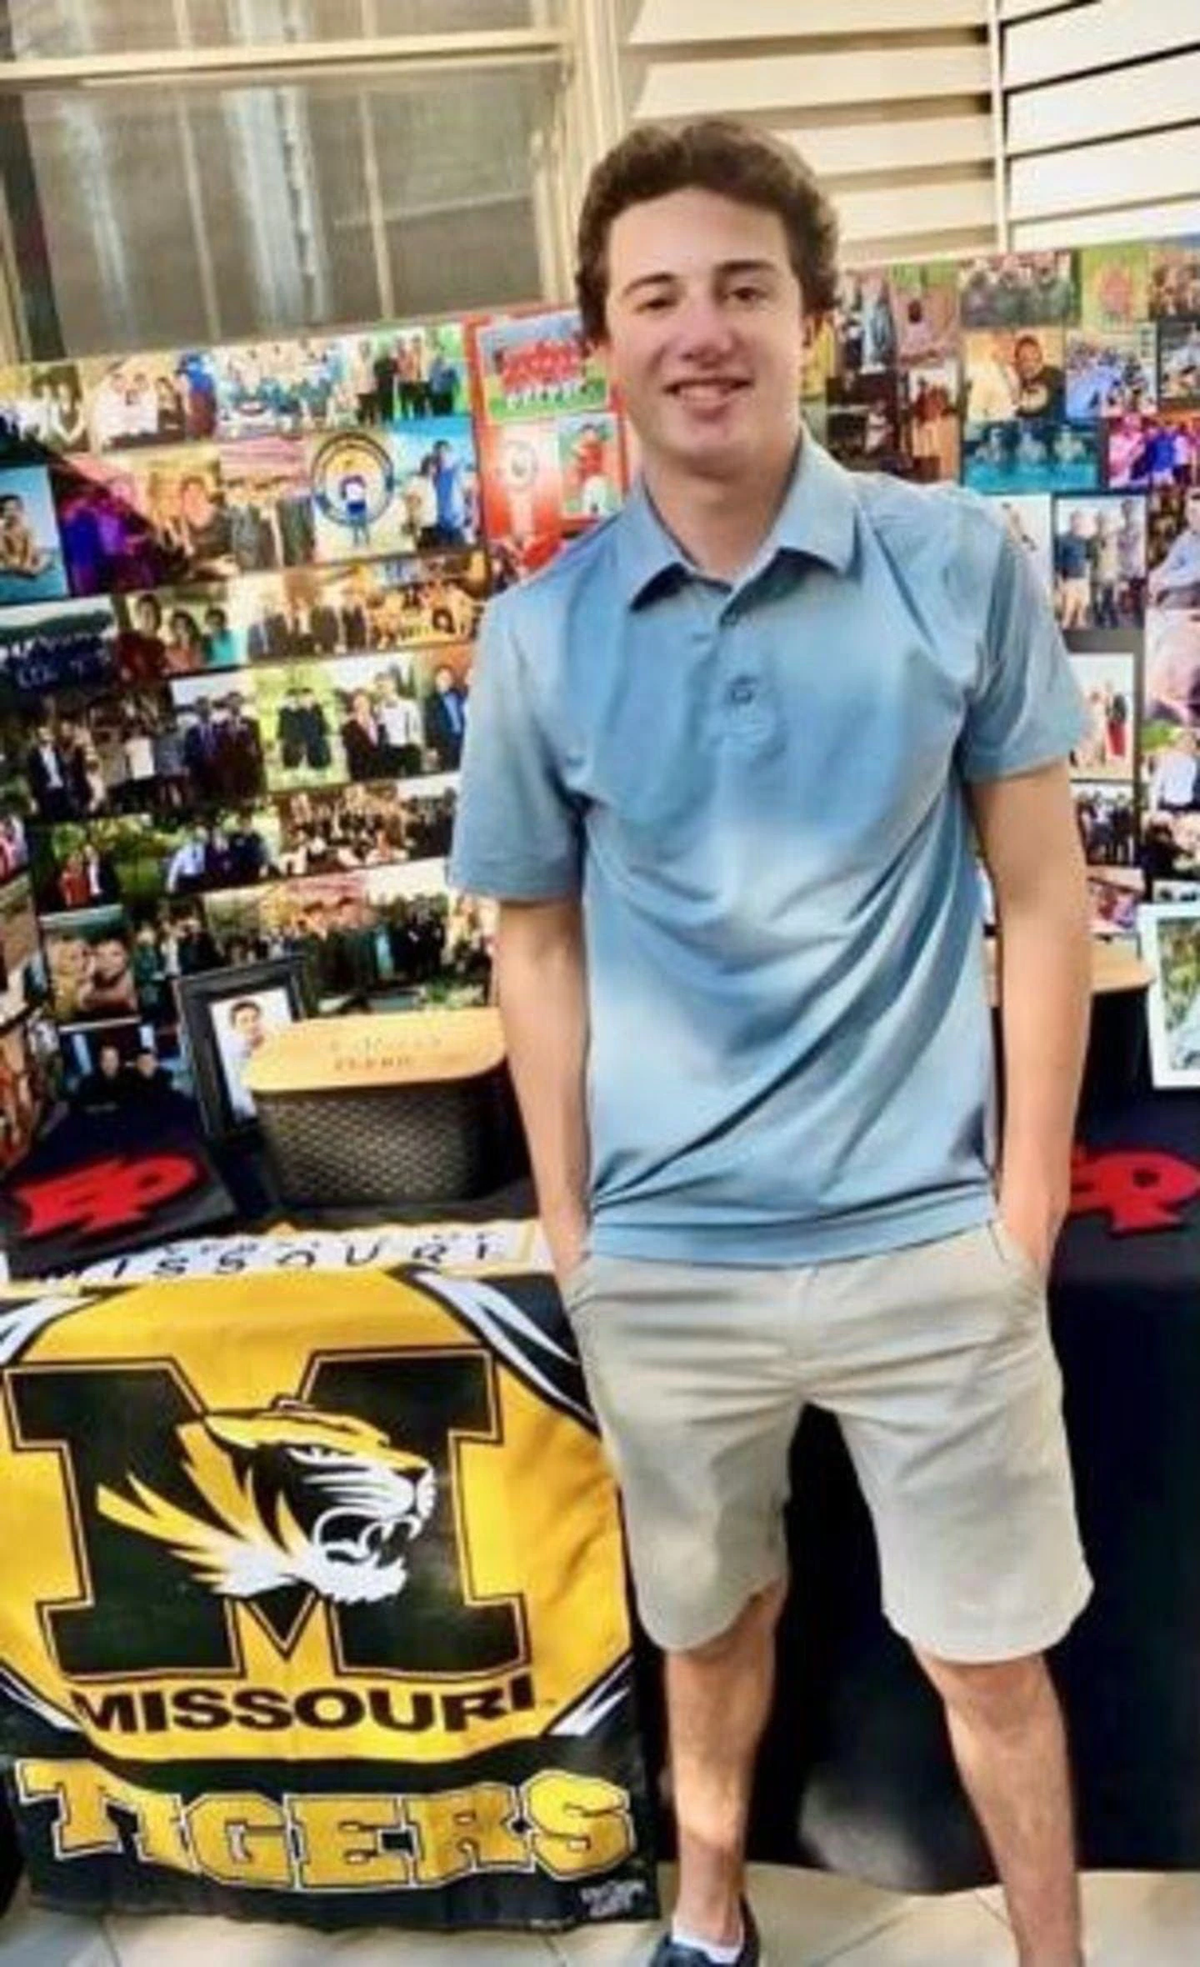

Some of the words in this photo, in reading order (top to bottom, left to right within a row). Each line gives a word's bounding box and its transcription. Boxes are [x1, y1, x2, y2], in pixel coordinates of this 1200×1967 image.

[45, 1242, 488, 1278] ISSOURI
[70, 1674, 536, 1733] MISSOURI
[15, 1758, 637, 1892] TIGERS
